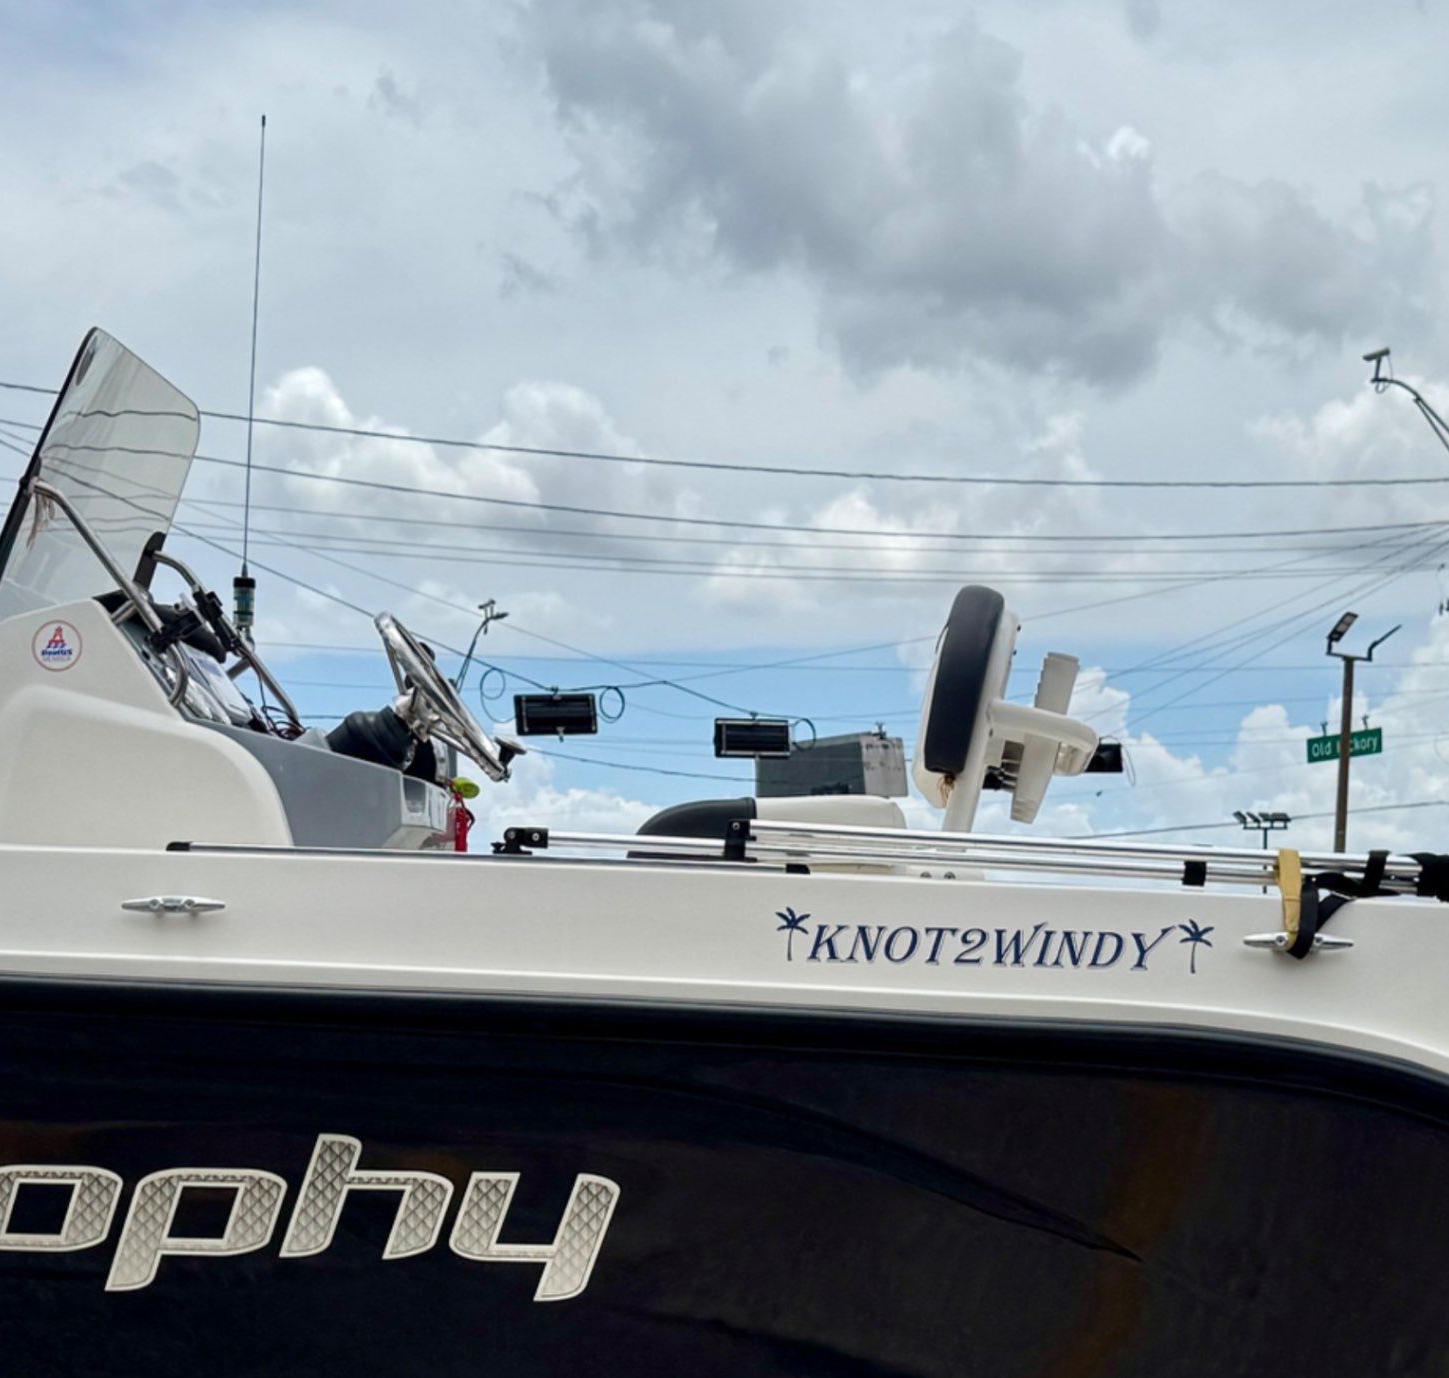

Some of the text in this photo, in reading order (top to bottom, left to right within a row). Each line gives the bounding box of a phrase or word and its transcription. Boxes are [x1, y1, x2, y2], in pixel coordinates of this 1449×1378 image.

[1312, 737, 1378, 757] Old kory
[806, 920, 1178, 972] KNOT2WINDY
